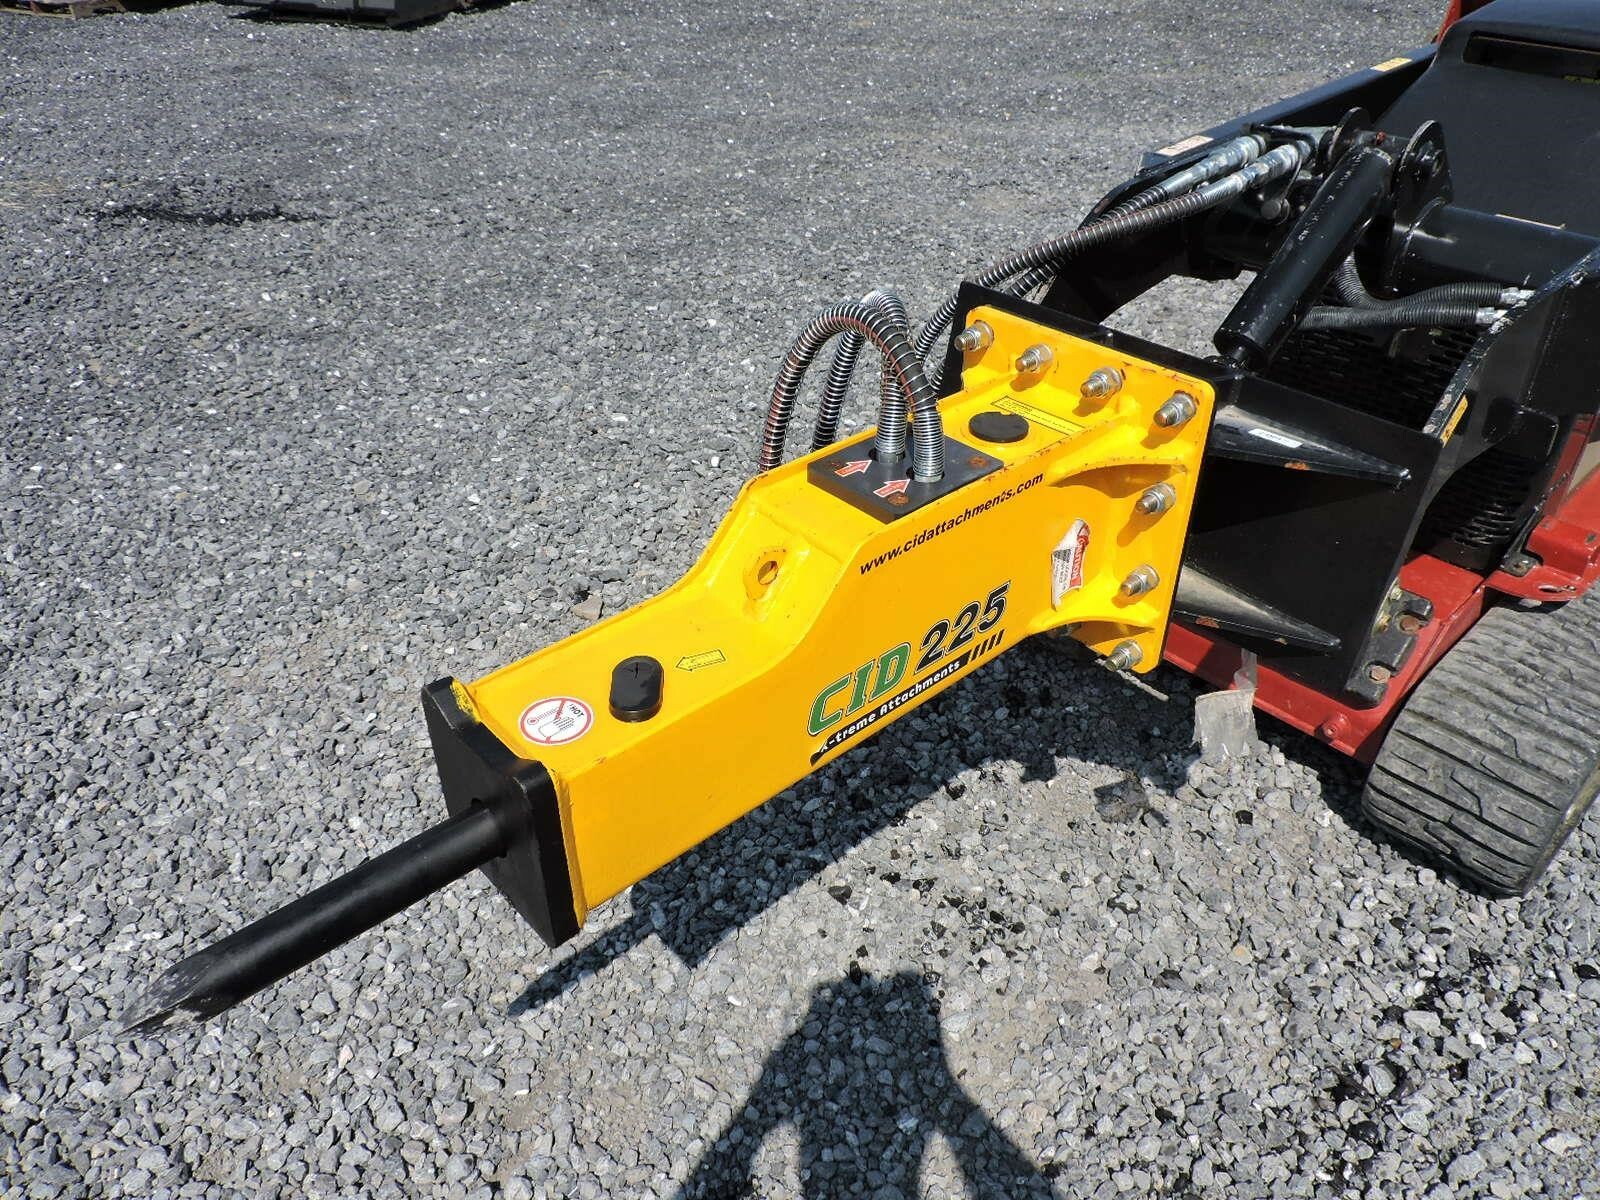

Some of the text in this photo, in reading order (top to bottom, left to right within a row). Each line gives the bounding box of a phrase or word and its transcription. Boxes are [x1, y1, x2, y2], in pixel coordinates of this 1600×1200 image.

[860, 473, 1044, 575] www.cidattachments.com
[808, 580, 1011, 736] CID 225
[880, 660, 960, 716] Attachments
